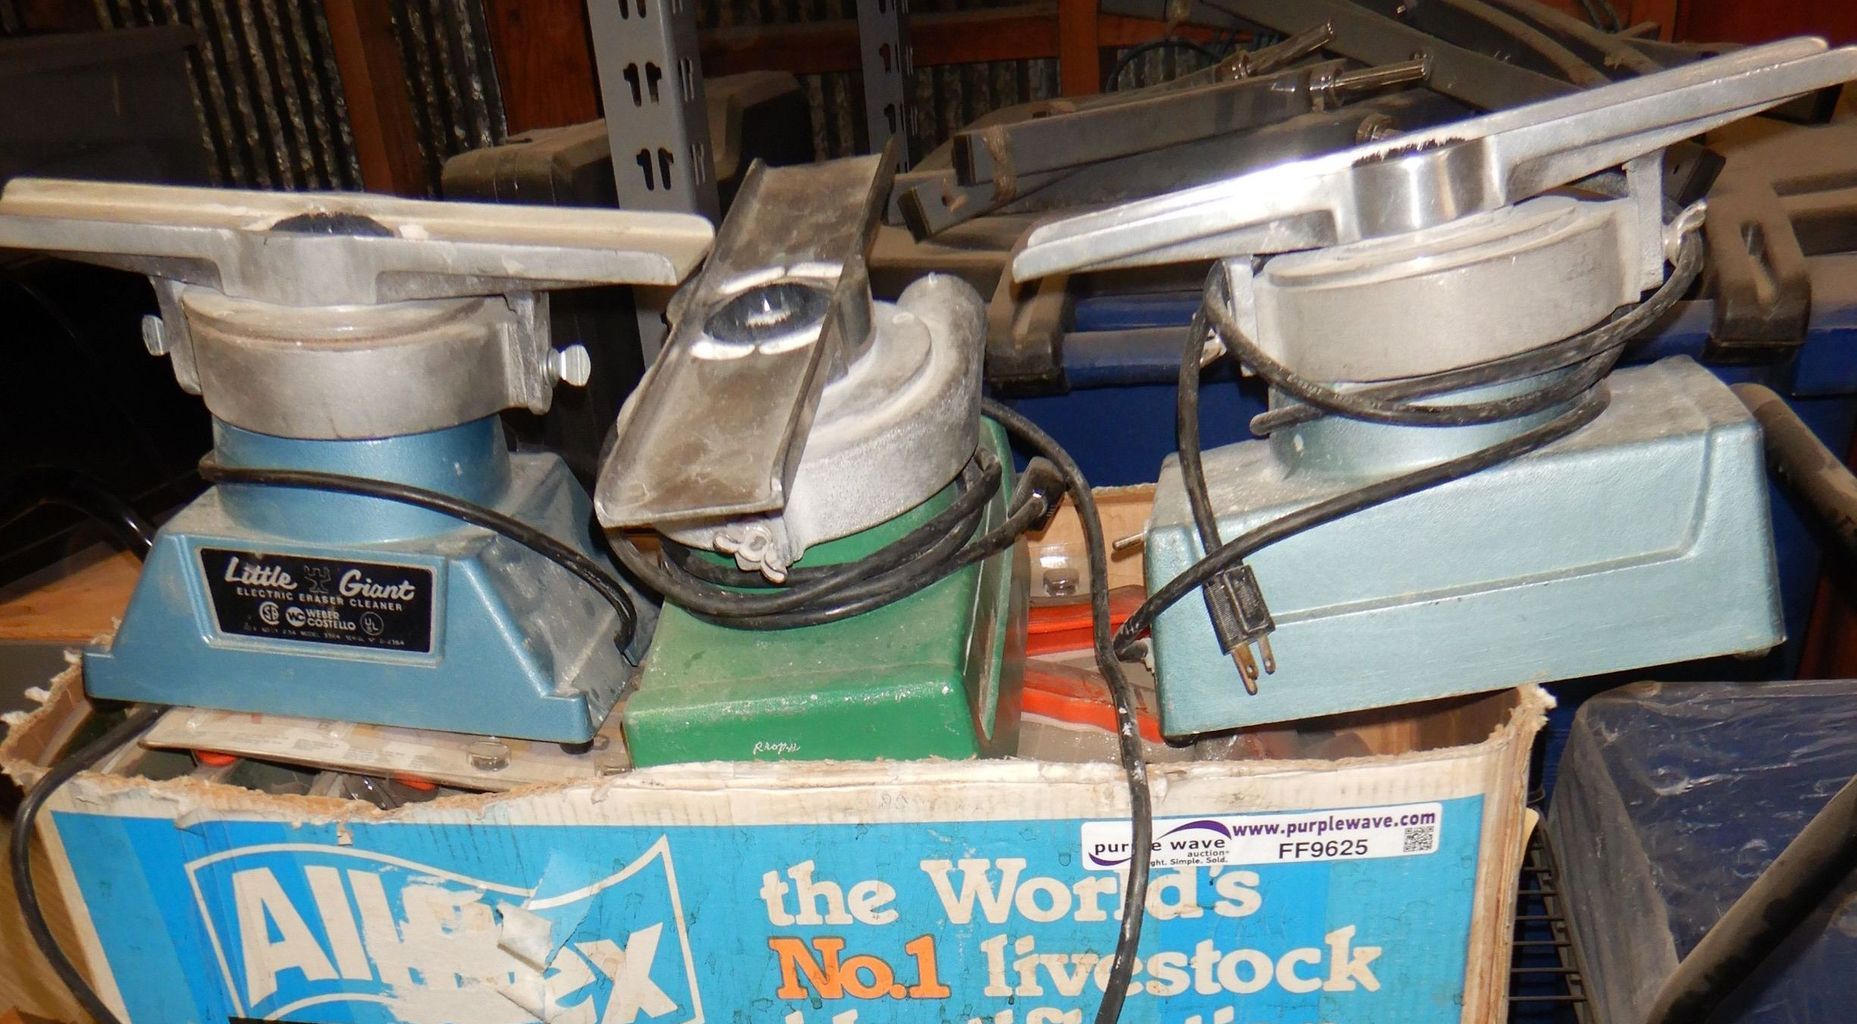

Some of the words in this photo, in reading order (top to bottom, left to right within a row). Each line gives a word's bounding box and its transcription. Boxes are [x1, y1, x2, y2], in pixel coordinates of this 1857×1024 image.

[225, 556, 298, 590] Little
[339, 569, 416, 600] Giant
[236, 587, 294, 600] ELECTRIC
[298, 593, 344, 606] ERASER
[350, 599, 403, 611] CLEANER
[306, 609, 340, 620] WEBER
[307, 618, 356, 631] COSTELLO
[1232, 812, 1436, 838] www.purplewave.com
[1095, 842, 1162, 855] pure
[1170, 838, 1225, 850] wave
[1279, 839, 1368, 859] FF9625
[1170, 857, 1203, 866] Simple.
[760, 858, 900, 927] the
[767, 934, 952, 1000] No.1
[979, 925, 1382, 998] livestock
